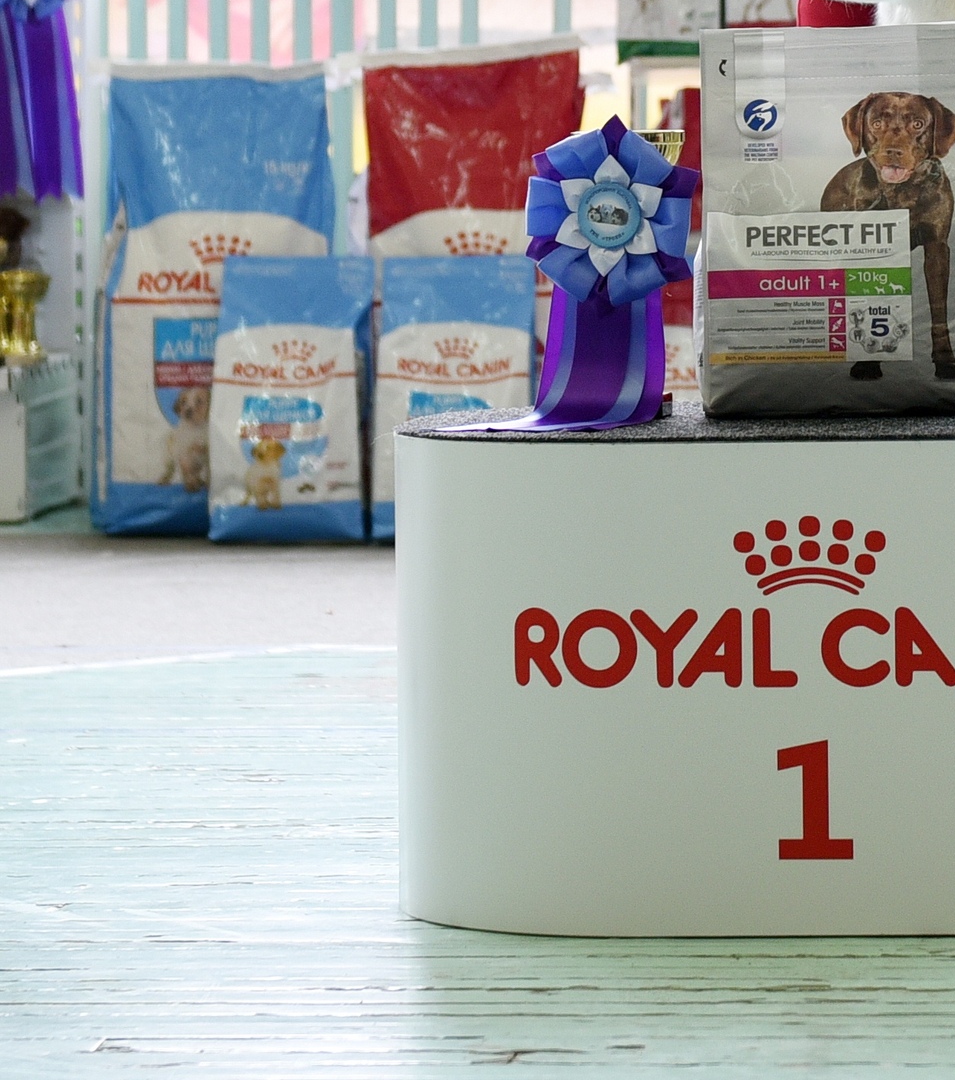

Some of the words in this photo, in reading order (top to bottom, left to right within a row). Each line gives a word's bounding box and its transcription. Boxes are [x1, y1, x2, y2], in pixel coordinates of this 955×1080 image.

[746, 223, 853, 247] PERFECT
[861, 222, 897, 245] FIT
[137, 271, 217, 293] ROYAL
[759, 276, 810, 291] adult
[818, 275, 840, 290] 1+
[868, 305, 891, 316] total
[870, 317, 890, 337] 5
[233, 362, 287, 380] ROYAL
[397, 358, 451, 377] ROYAL
[456, 357, 512, 378] CANIN
[514, 607, 798, 688] ROYAL
[776, 739, 854, 861] 1
